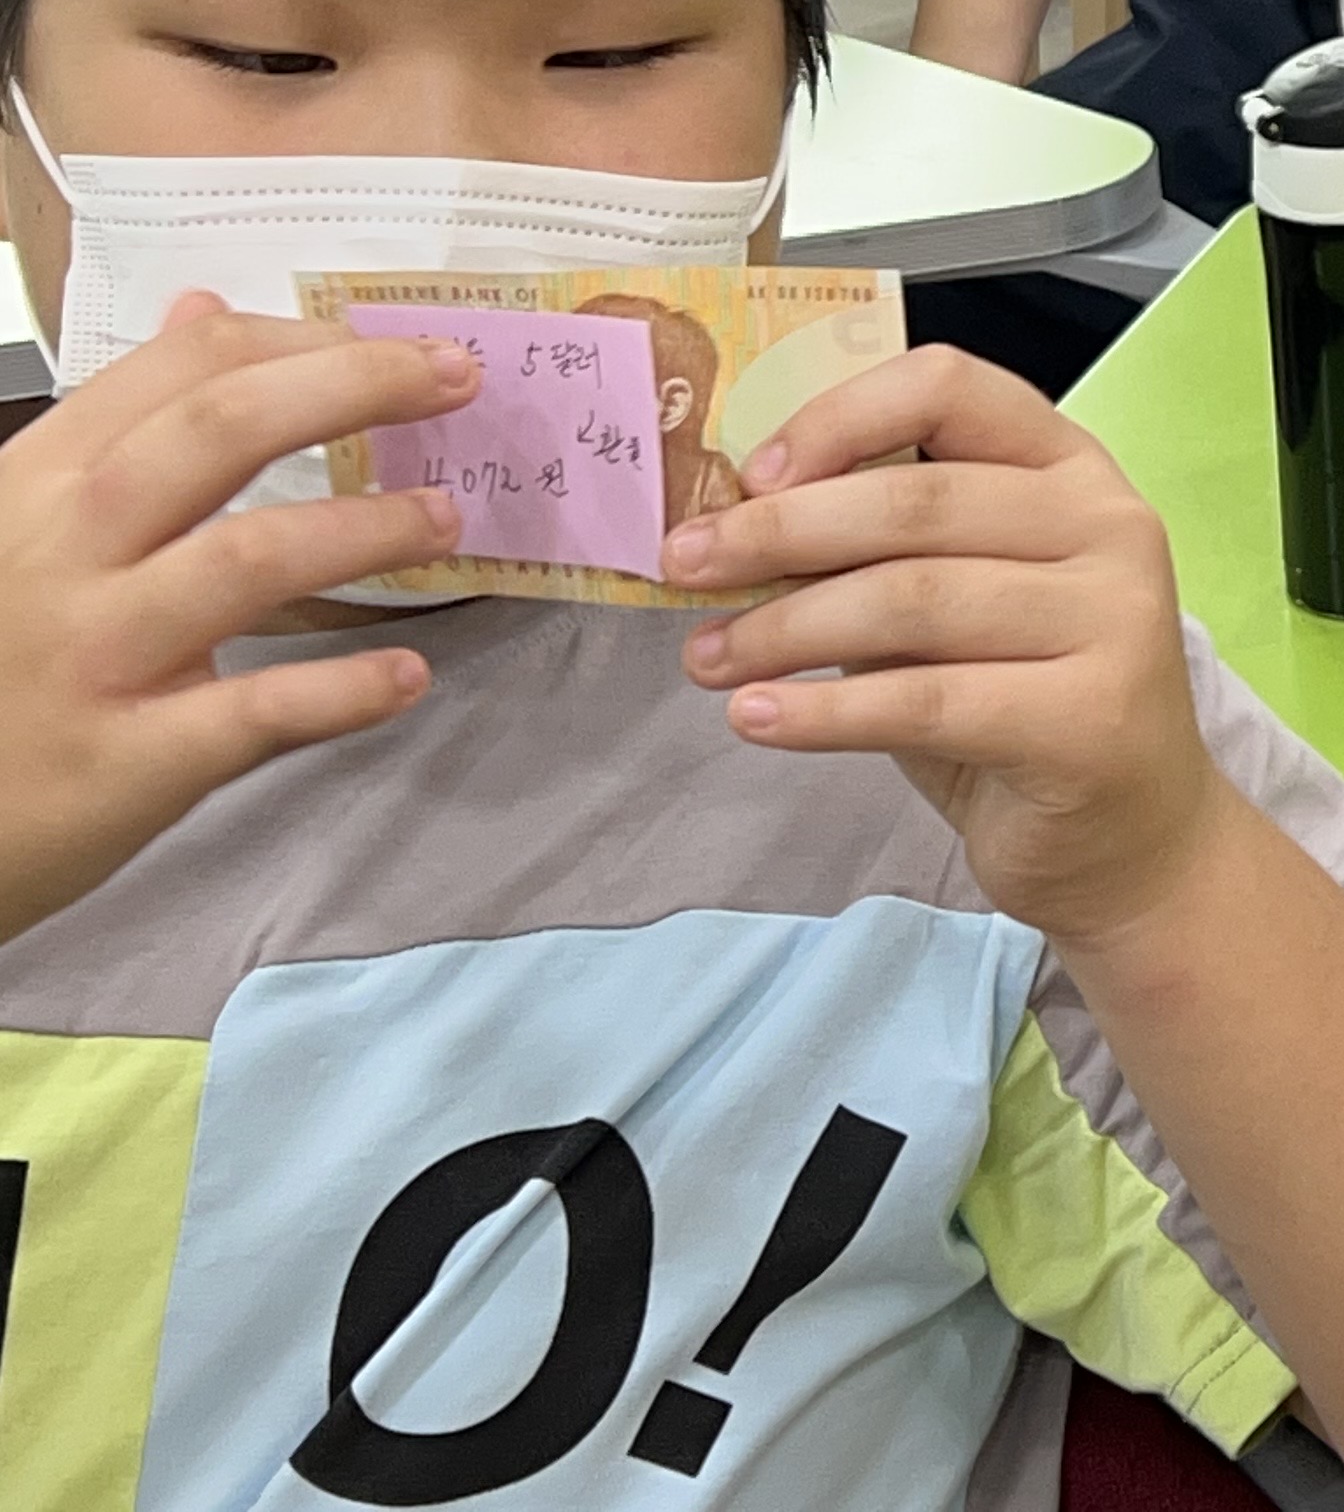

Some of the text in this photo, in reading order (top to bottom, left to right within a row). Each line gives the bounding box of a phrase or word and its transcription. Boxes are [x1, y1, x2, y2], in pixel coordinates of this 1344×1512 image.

[451, 286, 502, 303] BANK
[520, 341, 542, 377] 5
[550, 340, 602, 389] 달러
[535, 457, 570, 499] 원
[0, 1104, 908, 1508] O!
